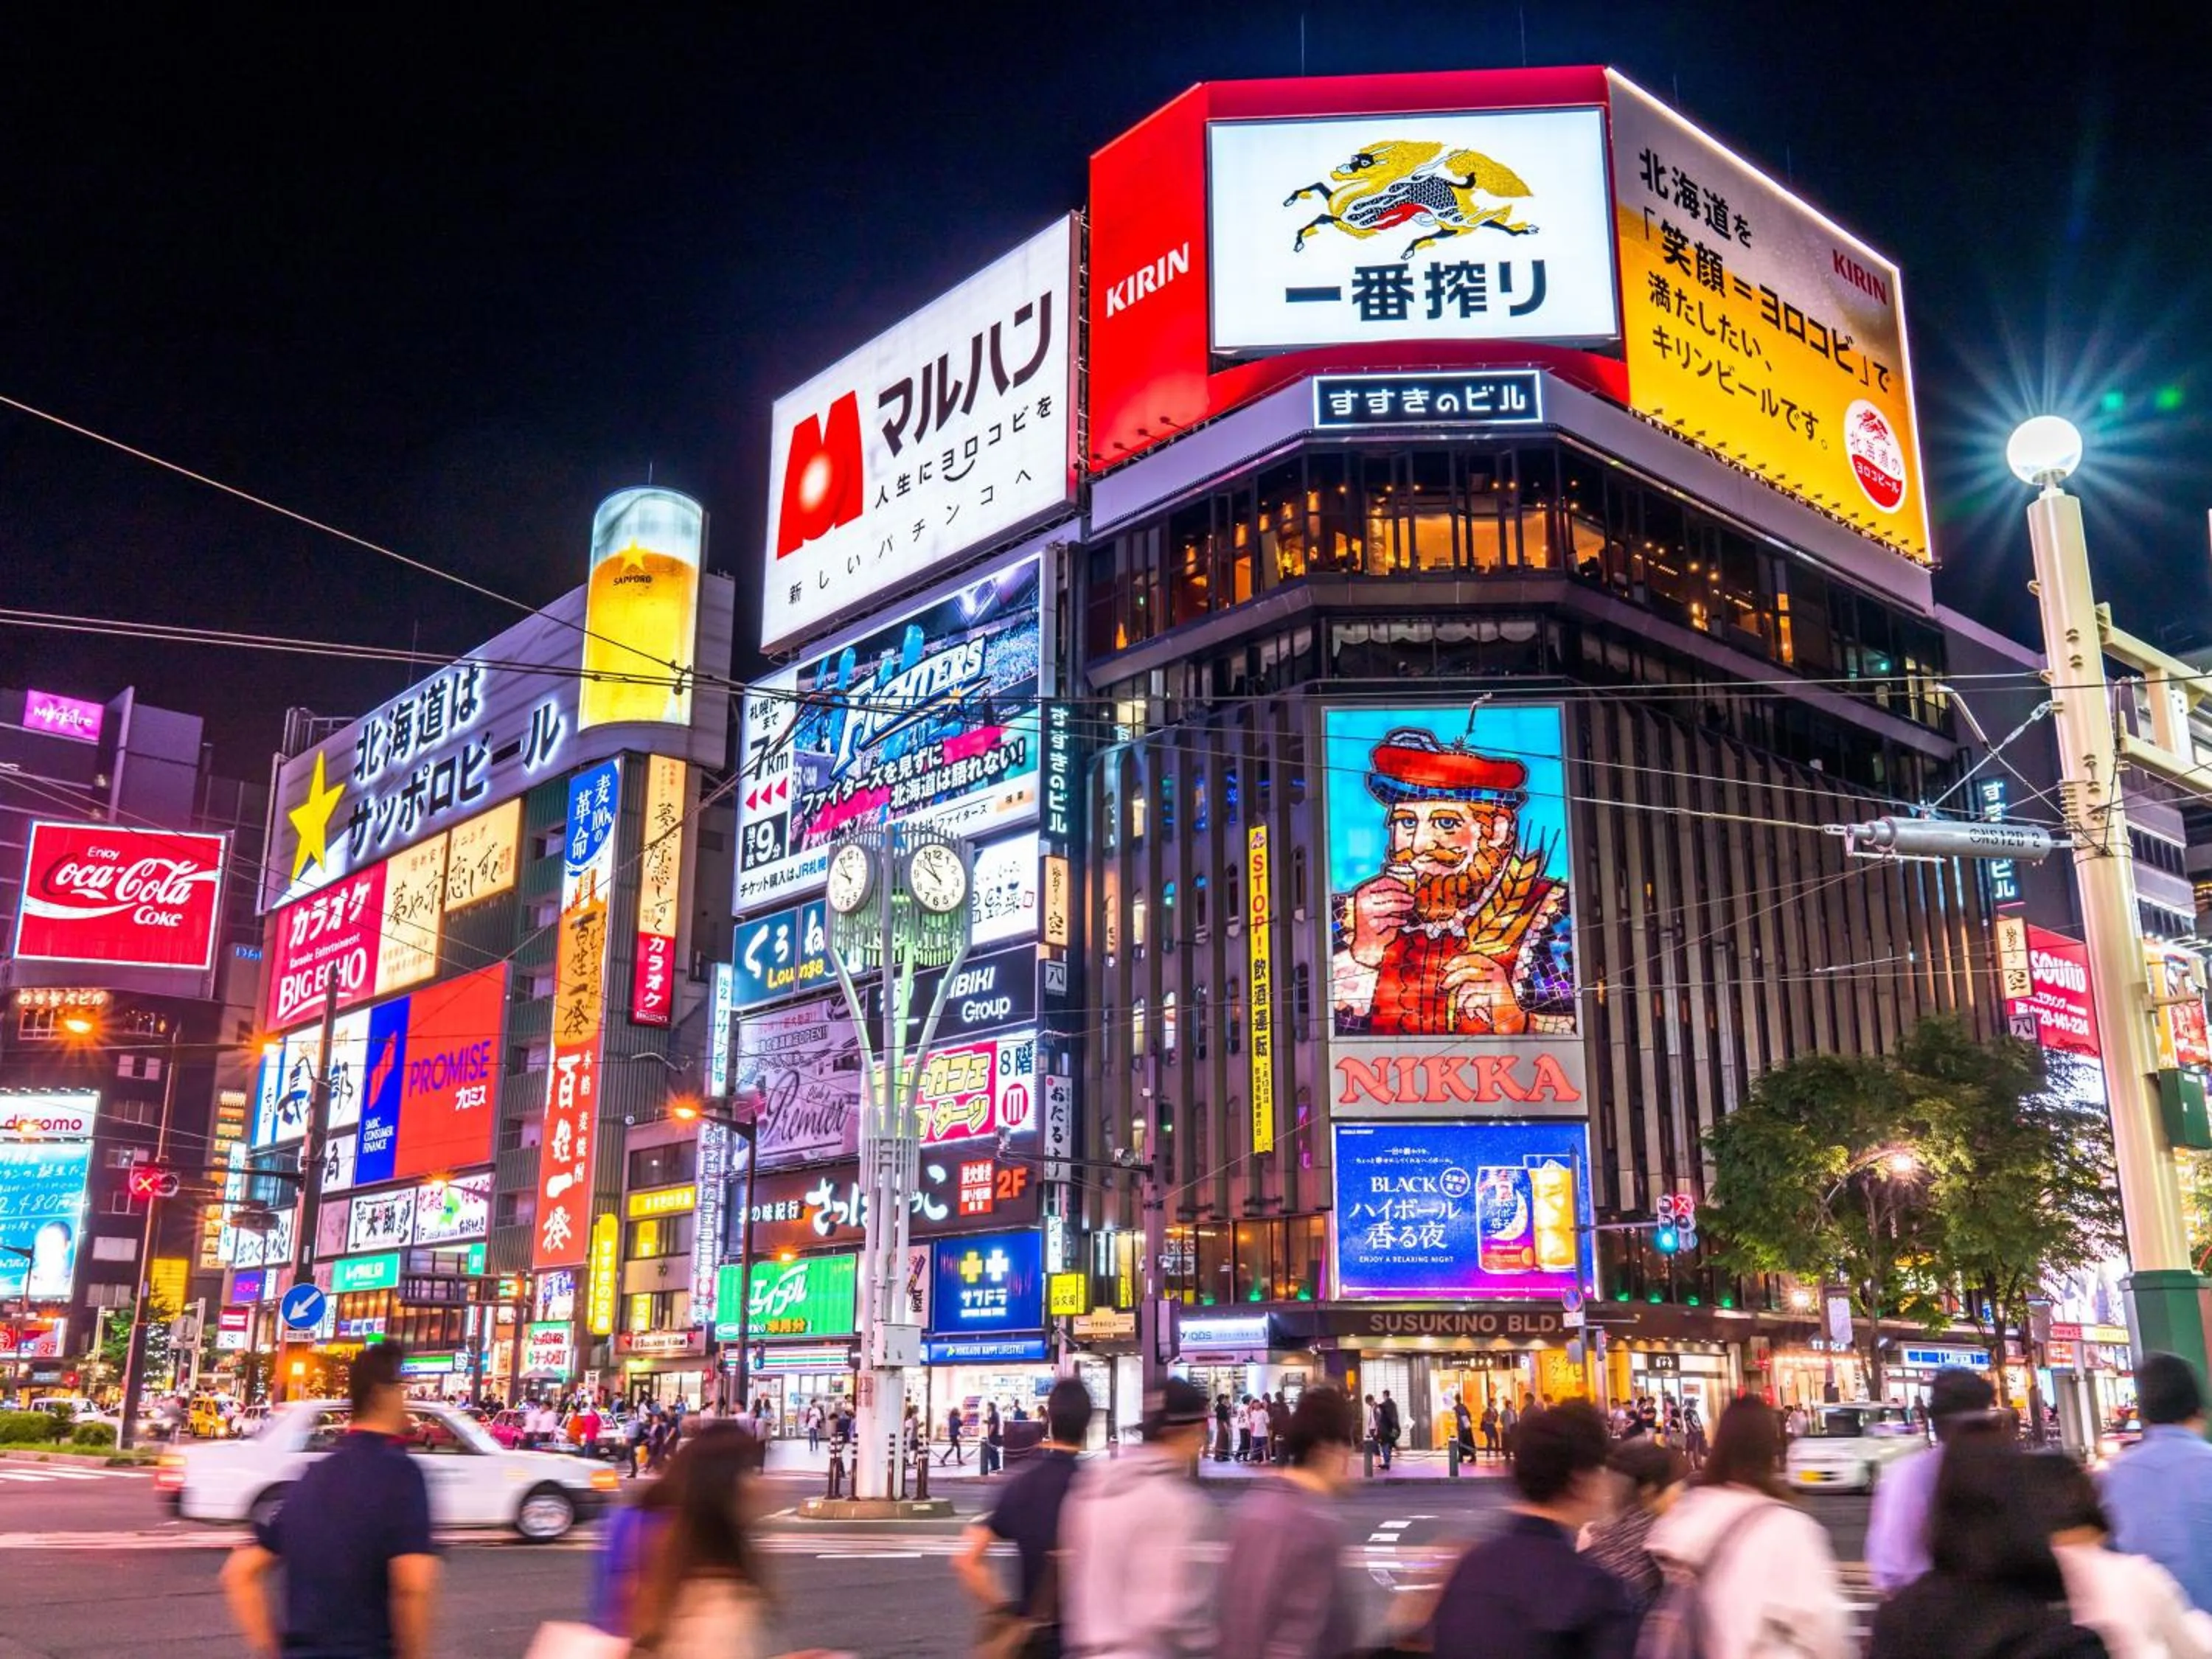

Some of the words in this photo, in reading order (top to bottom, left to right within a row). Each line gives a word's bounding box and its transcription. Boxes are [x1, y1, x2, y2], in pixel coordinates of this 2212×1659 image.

[1640, 148, 1752, 248] 北海道を
[1105, 243, 1189, 318] KIRIN
[1285, 259, 1546, 322] 一番搾り
[1832, 248, 1887, 305] KIRIN
[1648, 271, 1773, 372] 満たしたい、
[878, 291, 1051, 458] マルハン
[1329, 385, 1526, 415] すすきのビル
[1652, 325, 1829, 450] キリンビールです。
[874, 396, 1052, 509] 人生にヨロコビを
[788, 470, 1032, 605] 新しいパチンコへ
[613, 574, 652, 585] SAPPORO
[353, 663, 480, 782] 北海道は
[832, 636, 987, 776] FIGHTERS
[348, 703, 562, 858] サッポロビール
[802, 743, 944, 815] ファイターズを見ずに
[88, 846, 120, 860] Enjoy
[1983, 781, 2015, 898] すすビル
[41, 852, 198, 905] Coca-Cola
[1253, 854, 1266, 954] STOP!
[133, 905, 183, 926] Coke
[290, 882, 371, 949] カラオケ
[277, 972, 313, 1018] BIG
[315, 948, 366, 991] ECHO
[644, 936, 667, 1009] カラオケ
[767, 959, 824, 990] Lounge
[963, 997, 1011, 1023] Group
[408, 1040, 490, 1097] PROMISE
[999, 1040, 1033, 1076] 8階
[1335, 1054, 1581, 1105] NIKKA
[5, 1114, 83, 1131] domo
[455, 1085, 486, 1110] プロミス
[996, 1167, 1027, 1199] 2F
[1349, 1198, 1461, 1220] ハイボール
[1371, 1176, 1437, 1192] BLACK
[1366, 1221, 1448, 1250] 香る夜
[1370, 1313, 1498, 1333] SUSUKINO
[1508, 1313, 1565, 1333] BLD.
